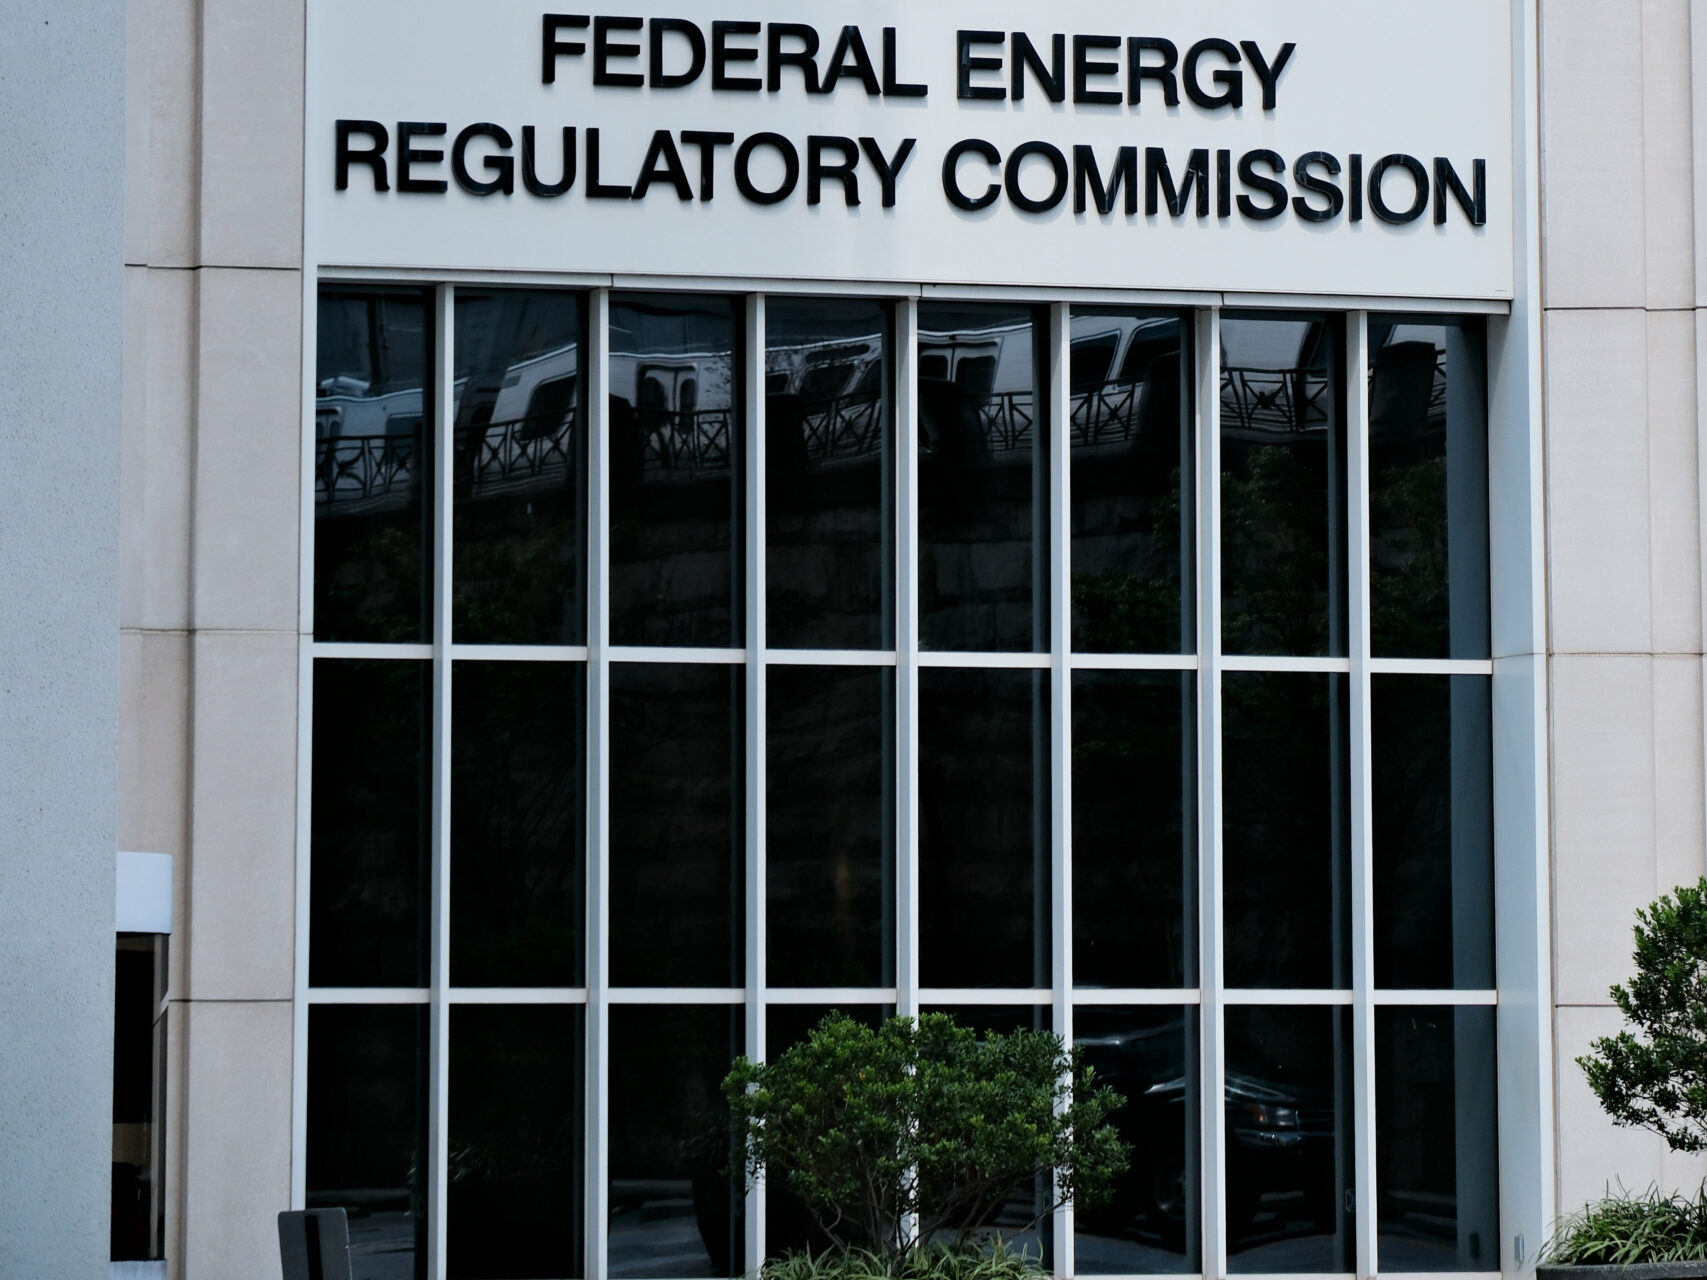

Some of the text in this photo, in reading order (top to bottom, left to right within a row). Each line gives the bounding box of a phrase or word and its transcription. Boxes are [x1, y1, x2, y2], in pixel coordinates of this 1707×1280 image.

[541, 13, 1297, 111] FEDERAL ENERGY
[334, 119, 1487, 228] REGULATORY COMMISSION
